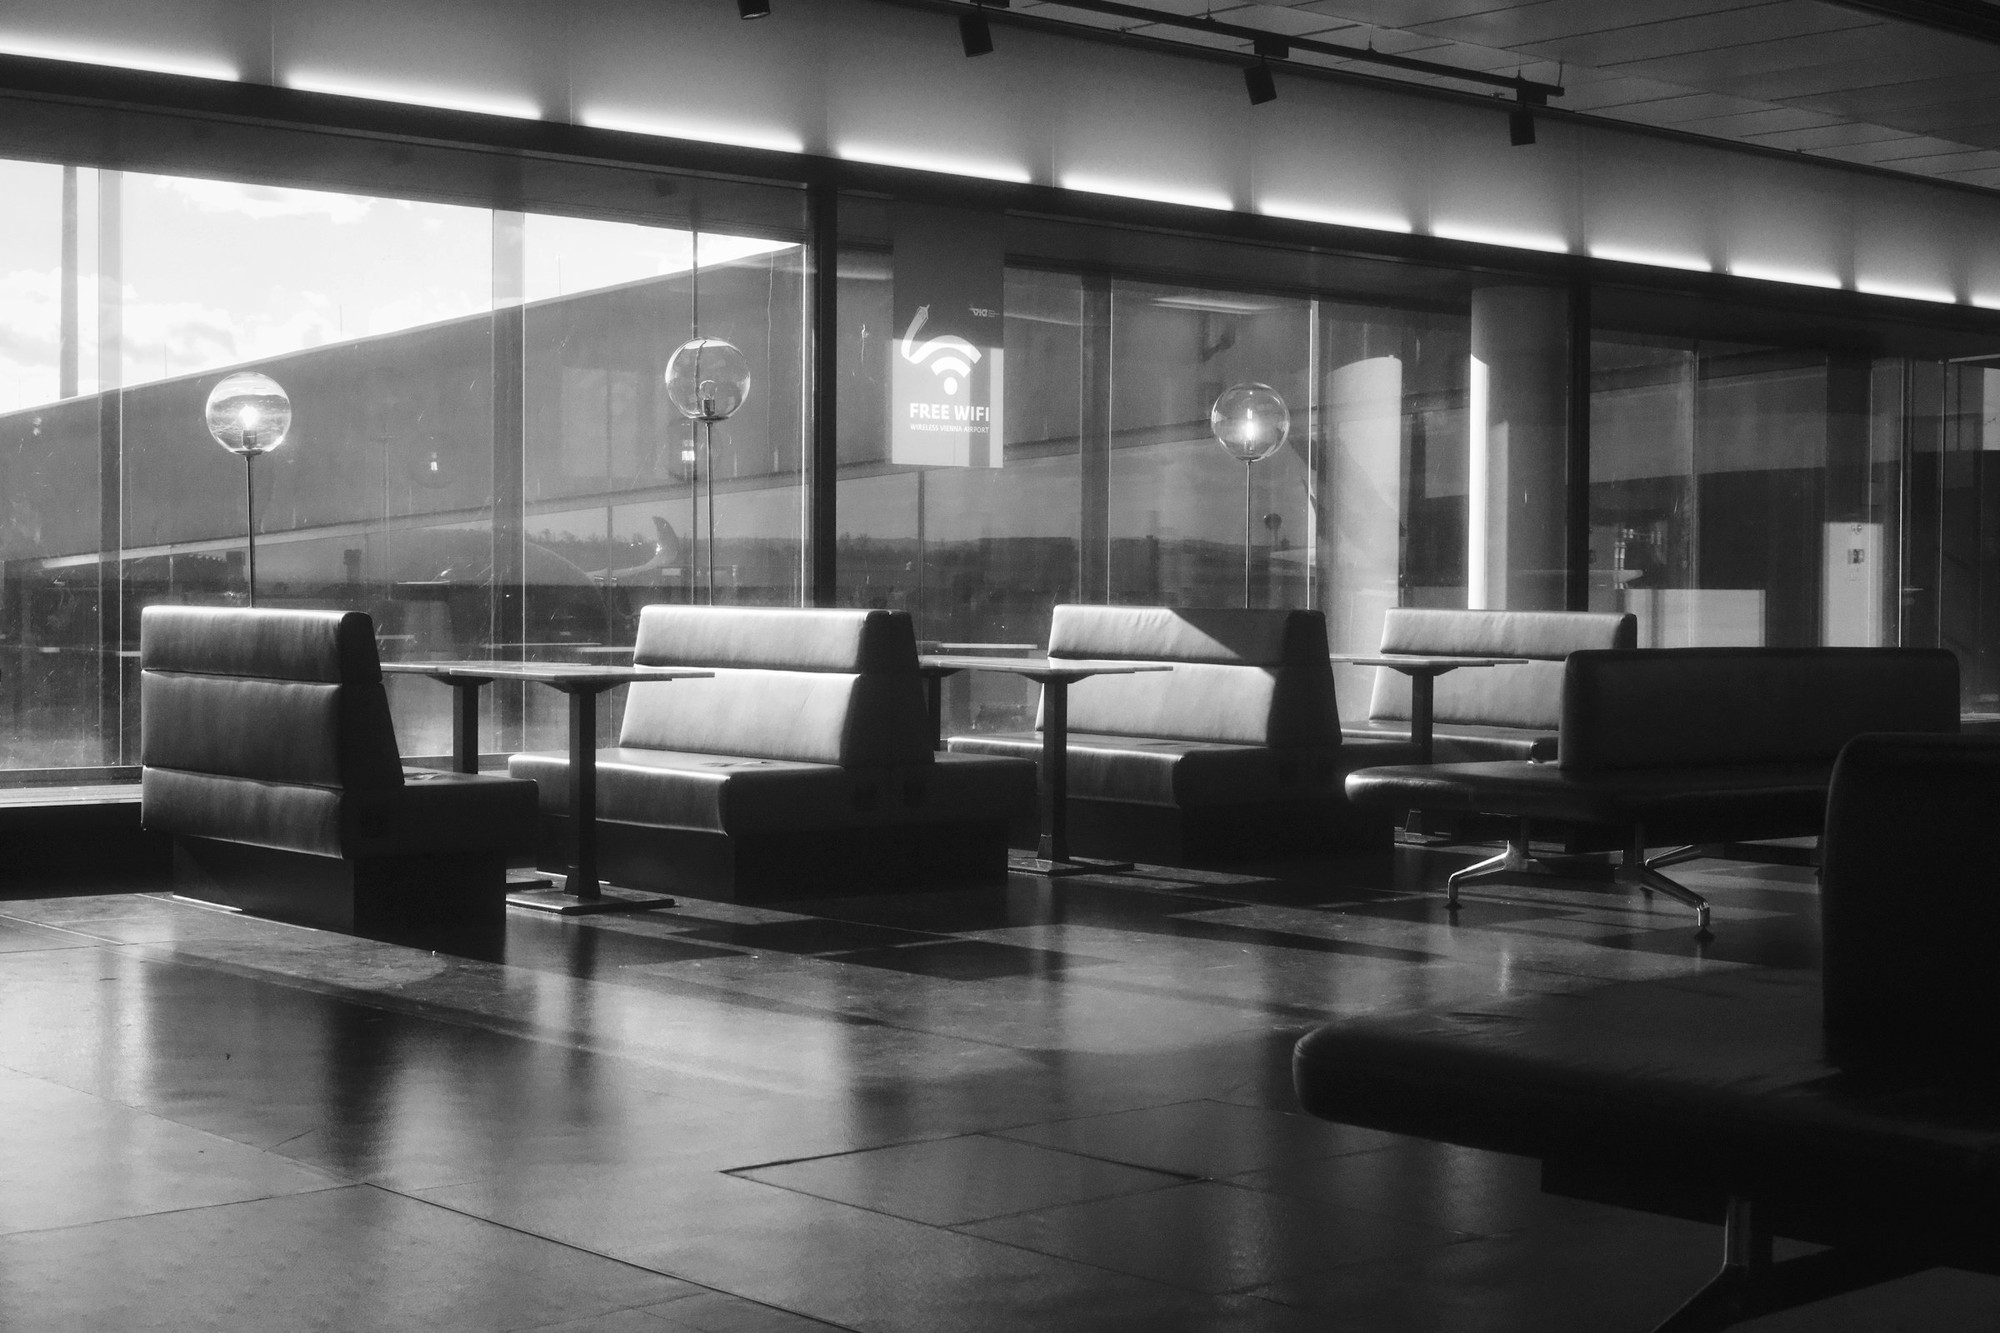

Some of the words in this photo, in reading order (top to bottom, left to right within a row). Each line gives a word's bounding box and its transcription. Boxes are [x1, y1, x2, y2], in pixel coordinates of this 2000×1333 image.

[909, 403, 950, 420] FREE
[954, 405, 989, 422] WIFI
[910, 423, 939, 432] WIRELESS
[940, 424, 963, 433] VIENNA
